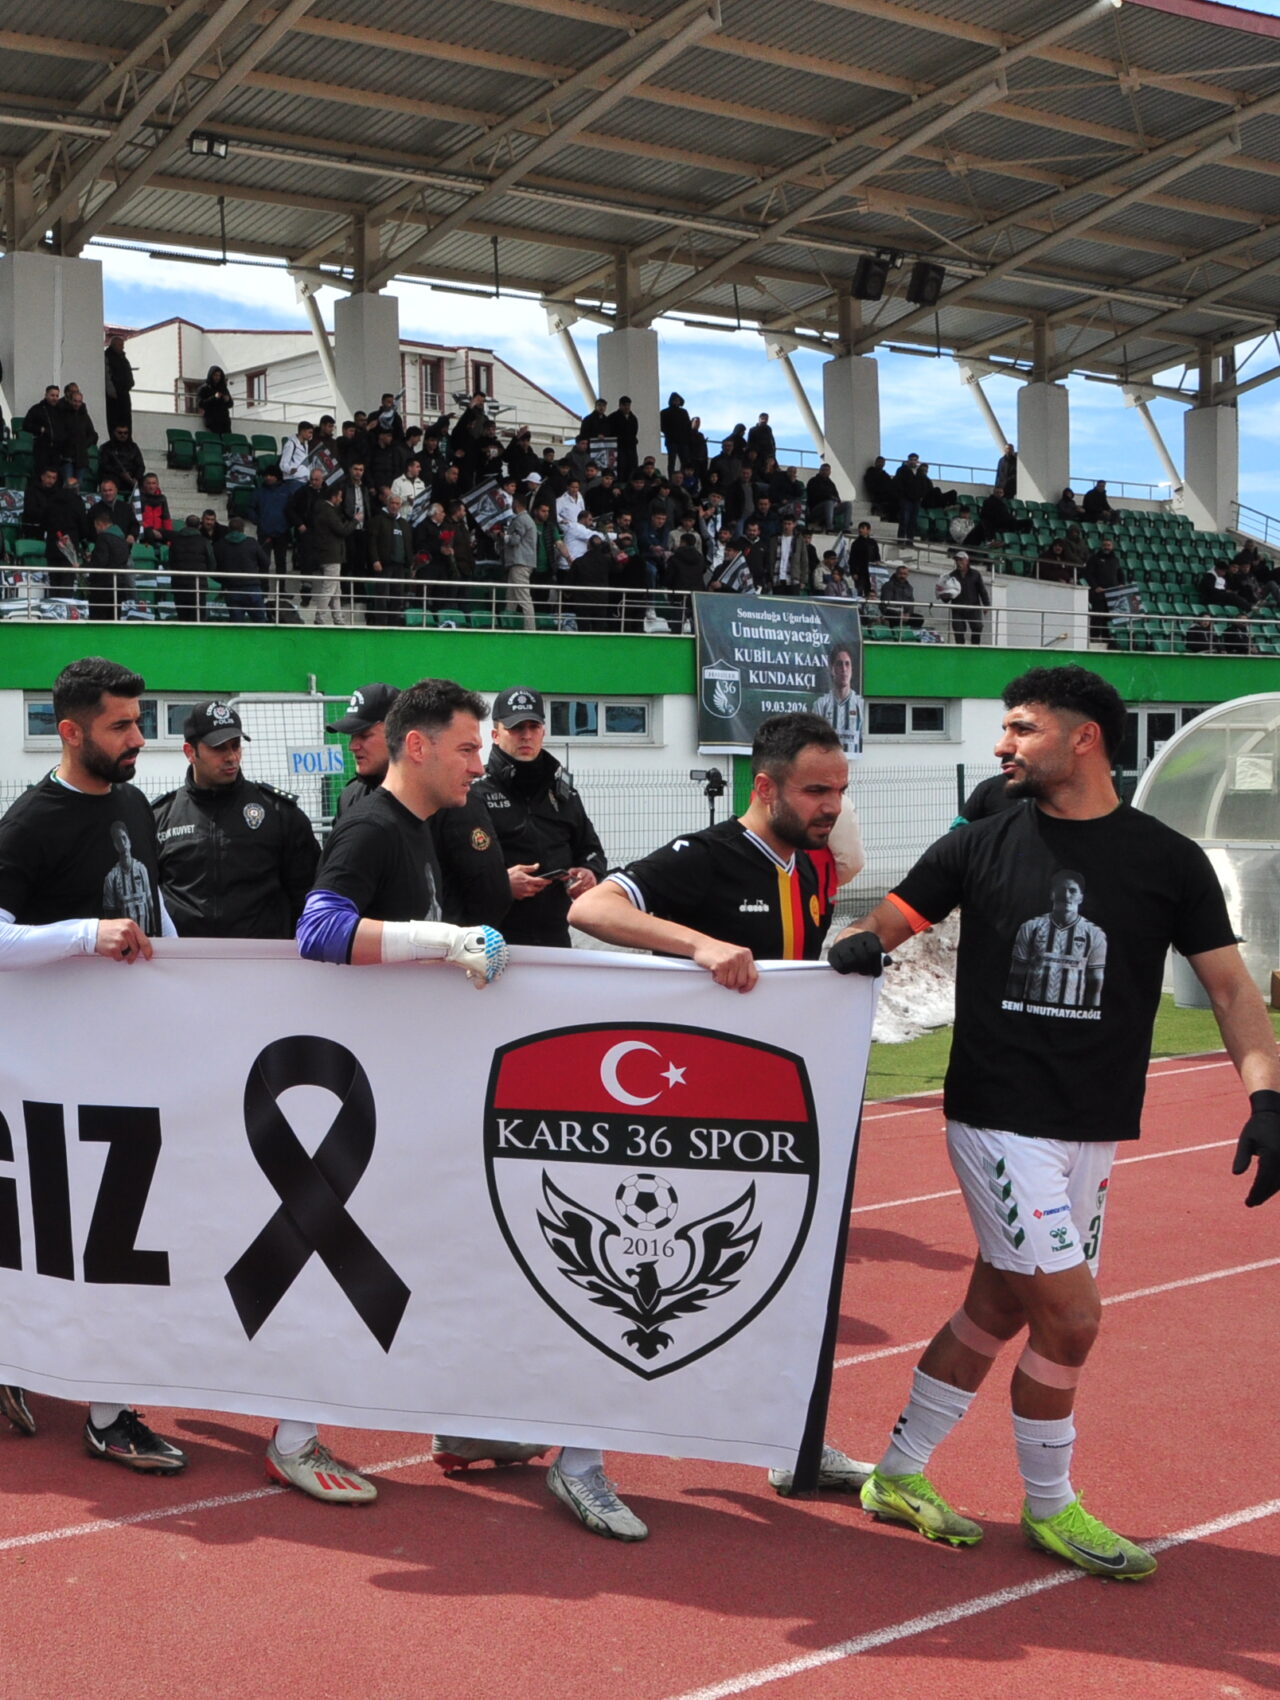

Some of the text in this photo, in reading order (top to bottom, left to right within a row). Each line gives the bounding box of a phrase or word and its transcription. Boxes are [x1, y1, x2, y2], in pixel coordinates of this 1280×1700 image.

[731, 621, 831, 648] Unutmayacağız
[734, 647, 829, 668] KUBİLAY KAAN
[722, 680, 737, 694] 36
[748, 669, 817, 690] KUNDAKÇI
[292, 747, 345, 773] POLİS
[1001, 999, 1102, 1020] SENİ UNUTMAYACAĞIZ
[495, 1117, 805, 1164] KARS 36 SPOR
[622, 1236, 675, 1259] 2016
